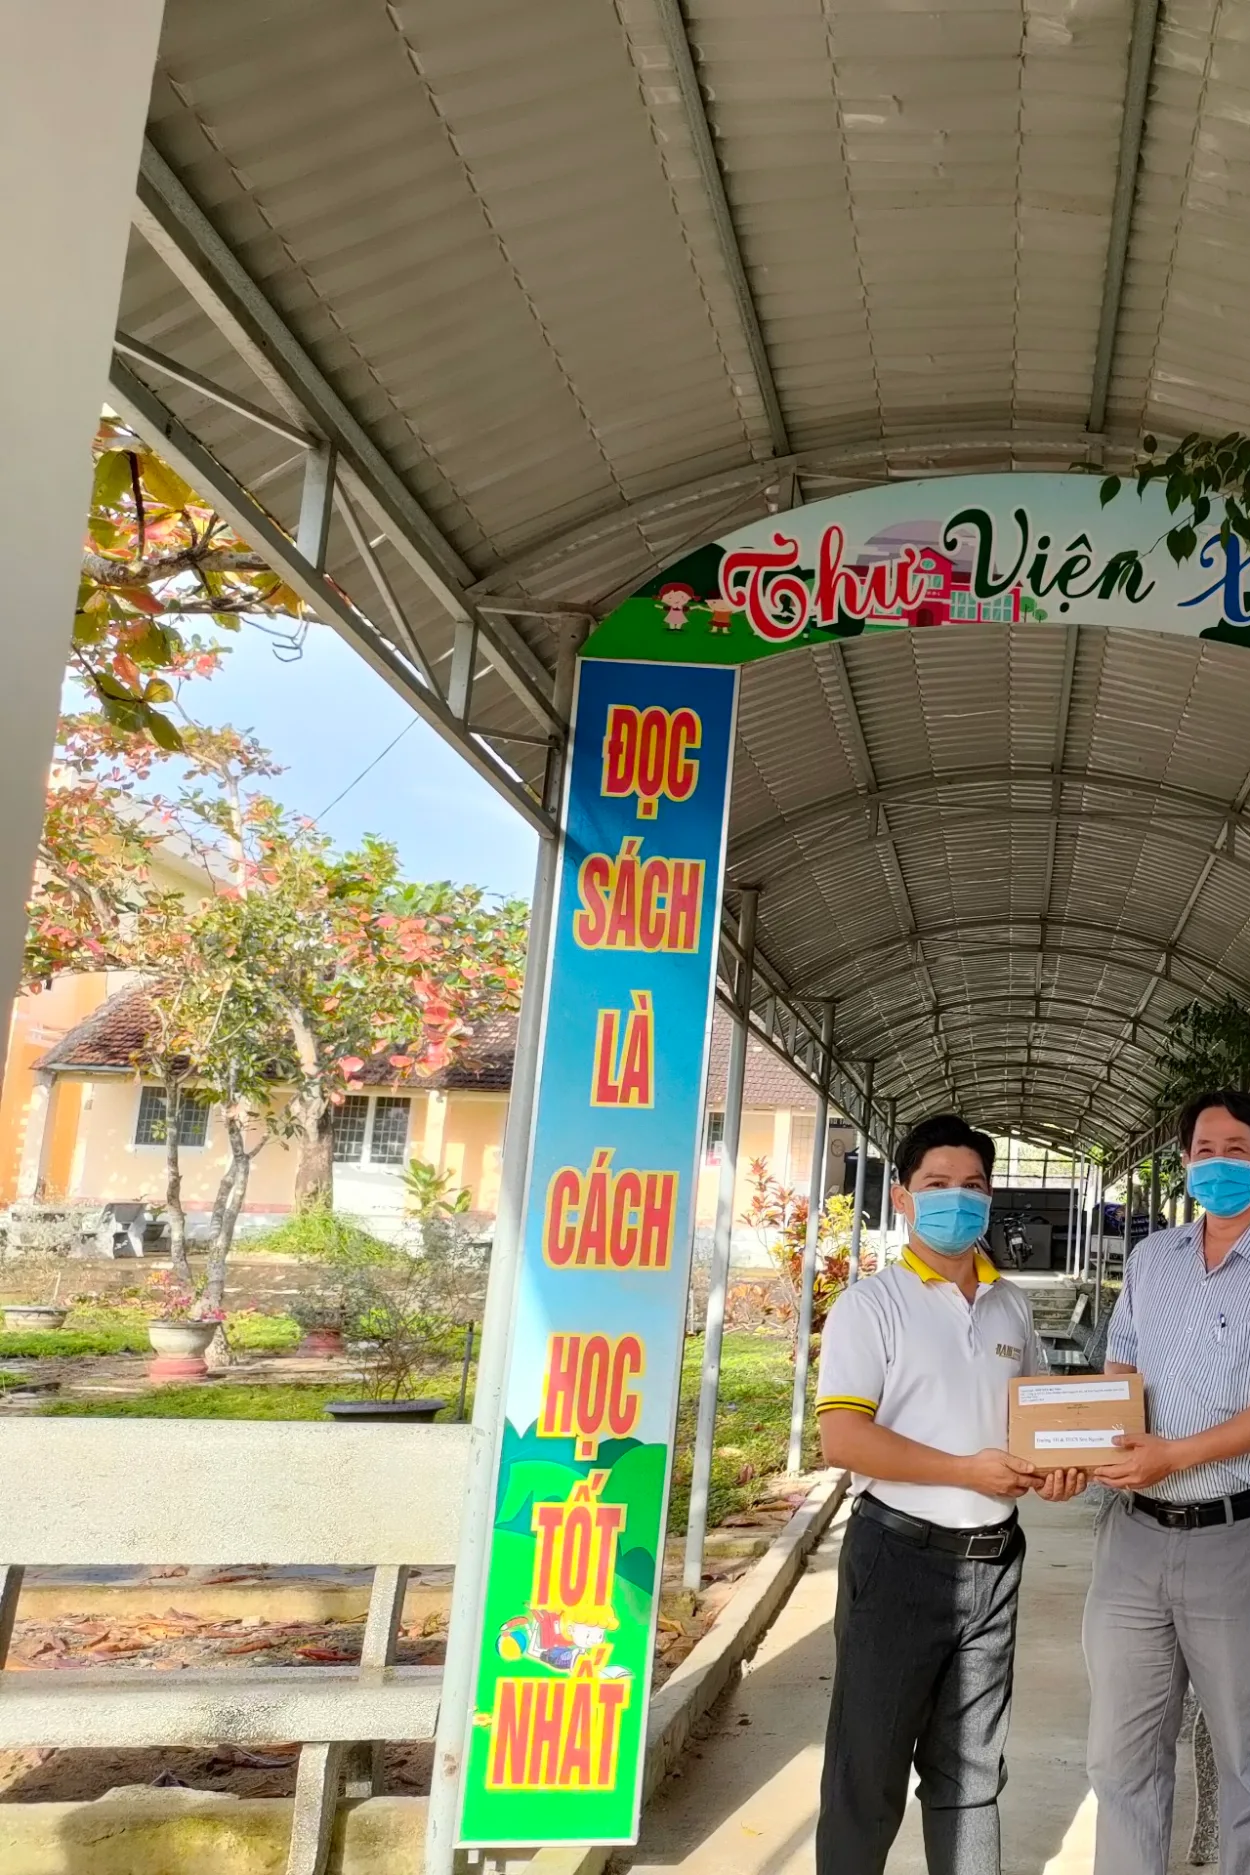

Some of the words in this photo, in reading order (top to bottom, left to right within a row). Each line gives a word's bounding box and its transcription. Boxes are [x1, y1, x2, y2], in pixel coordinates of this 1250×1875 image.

[722, 524, 926, 640] Thư
[942, 507, 1156, 614] Viện
[602, 705, 701, 819] ĐỌC
[574, 836, 705, 954] SÁCH
[590, 990, 654, 1108] LÀ
[542, 1147, 679, 1268] CÁCH
[537, 1333, 647, 1461] HỌC
[531, 1468, 627, 1607] TỐT
[486, 1643, 630, 1791] NHẤT
